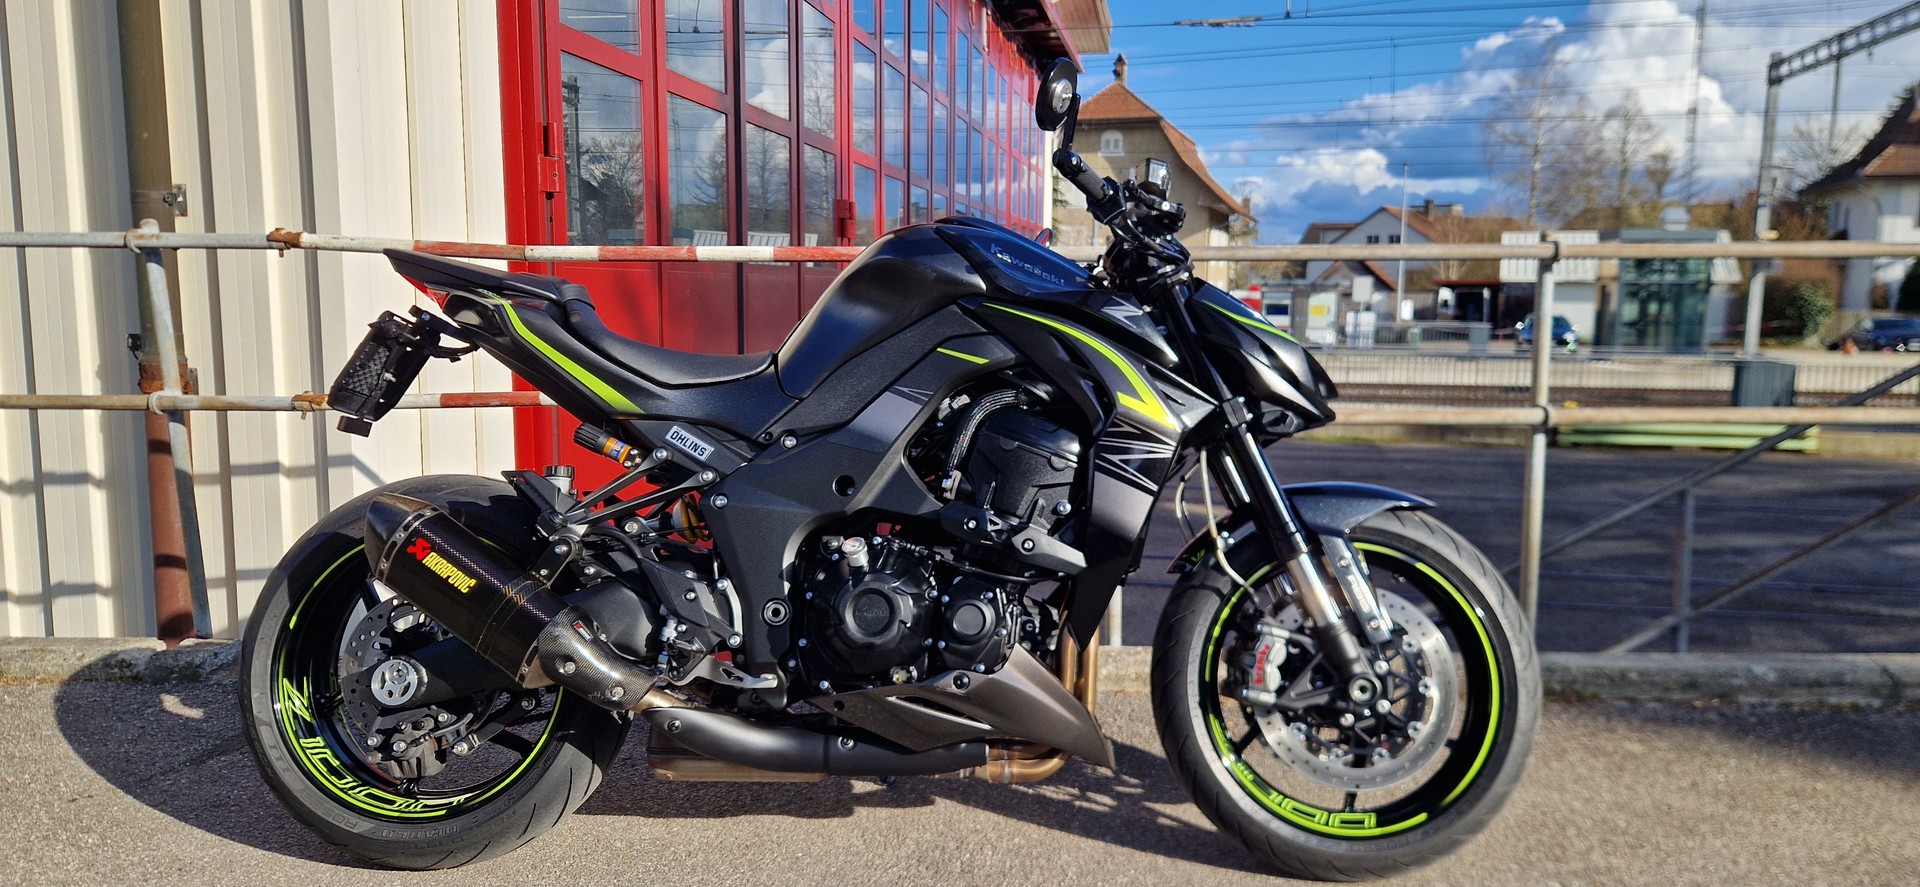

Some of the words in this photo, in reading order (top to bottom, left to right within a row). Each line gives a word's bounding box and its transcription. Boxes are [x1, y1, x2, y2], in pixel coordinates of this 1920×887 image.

[990, 243, 1065, 287] Kawasaki
[669, 427, 708, 457] ÖHLINS
[1346, 574, 1370, 614] ABS
[1253, 644, 1272, 685] brembo
[298, 790, 359, 830] ROSSO
[381, 823, 459, 839] DIABLO
